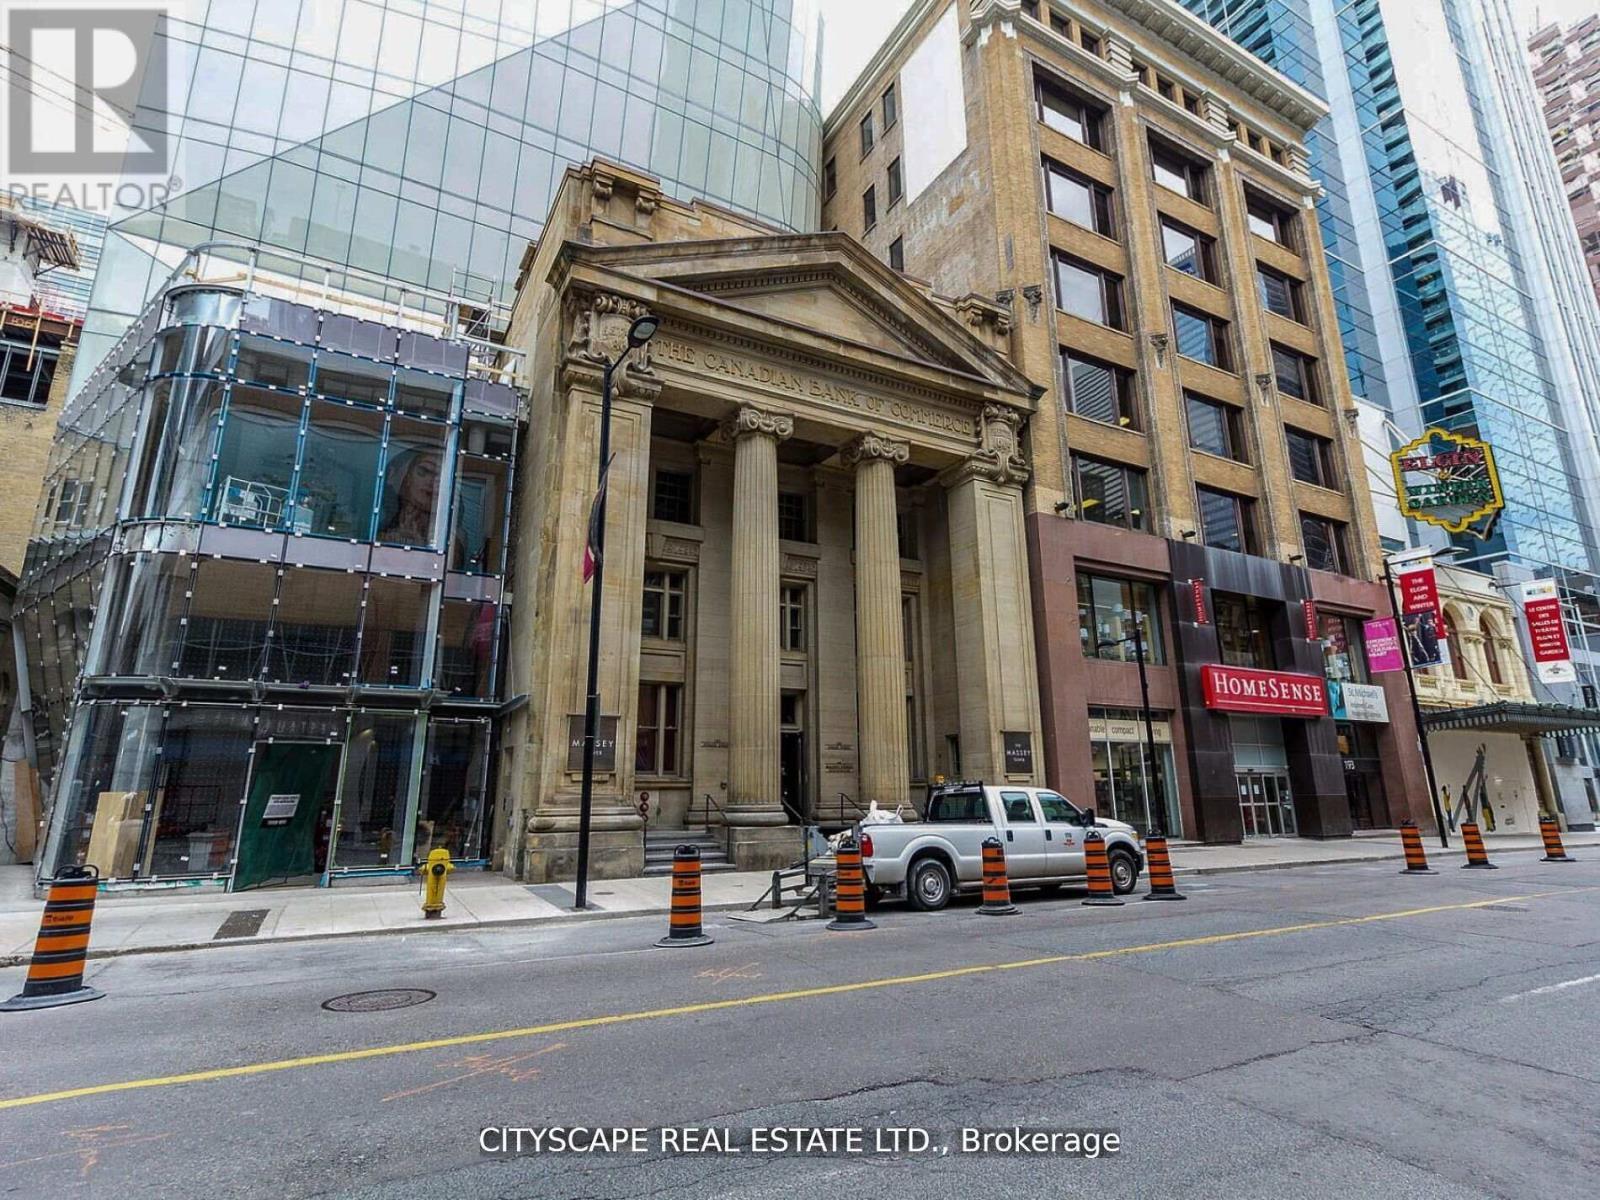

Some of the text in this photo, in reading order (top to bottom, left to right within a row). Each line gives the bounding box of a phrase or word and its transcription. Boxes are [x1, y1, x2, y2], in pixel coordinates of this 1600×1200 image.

[655, 341, 971, 435] THE CANADIAN BANK OF COMMERCE
[1399, 447, 1484, 472] ELGIN
[1410, 577, 1424, 585] THE
[1409, 585, 1429, 593] ELGIN
[1409, 601, 1435, 610] WINTER
[1112, 726, 1135, 736] compact
[571, 739, 614, 748] MSEY
[1006, 749, 1031, 757] MASSEY
